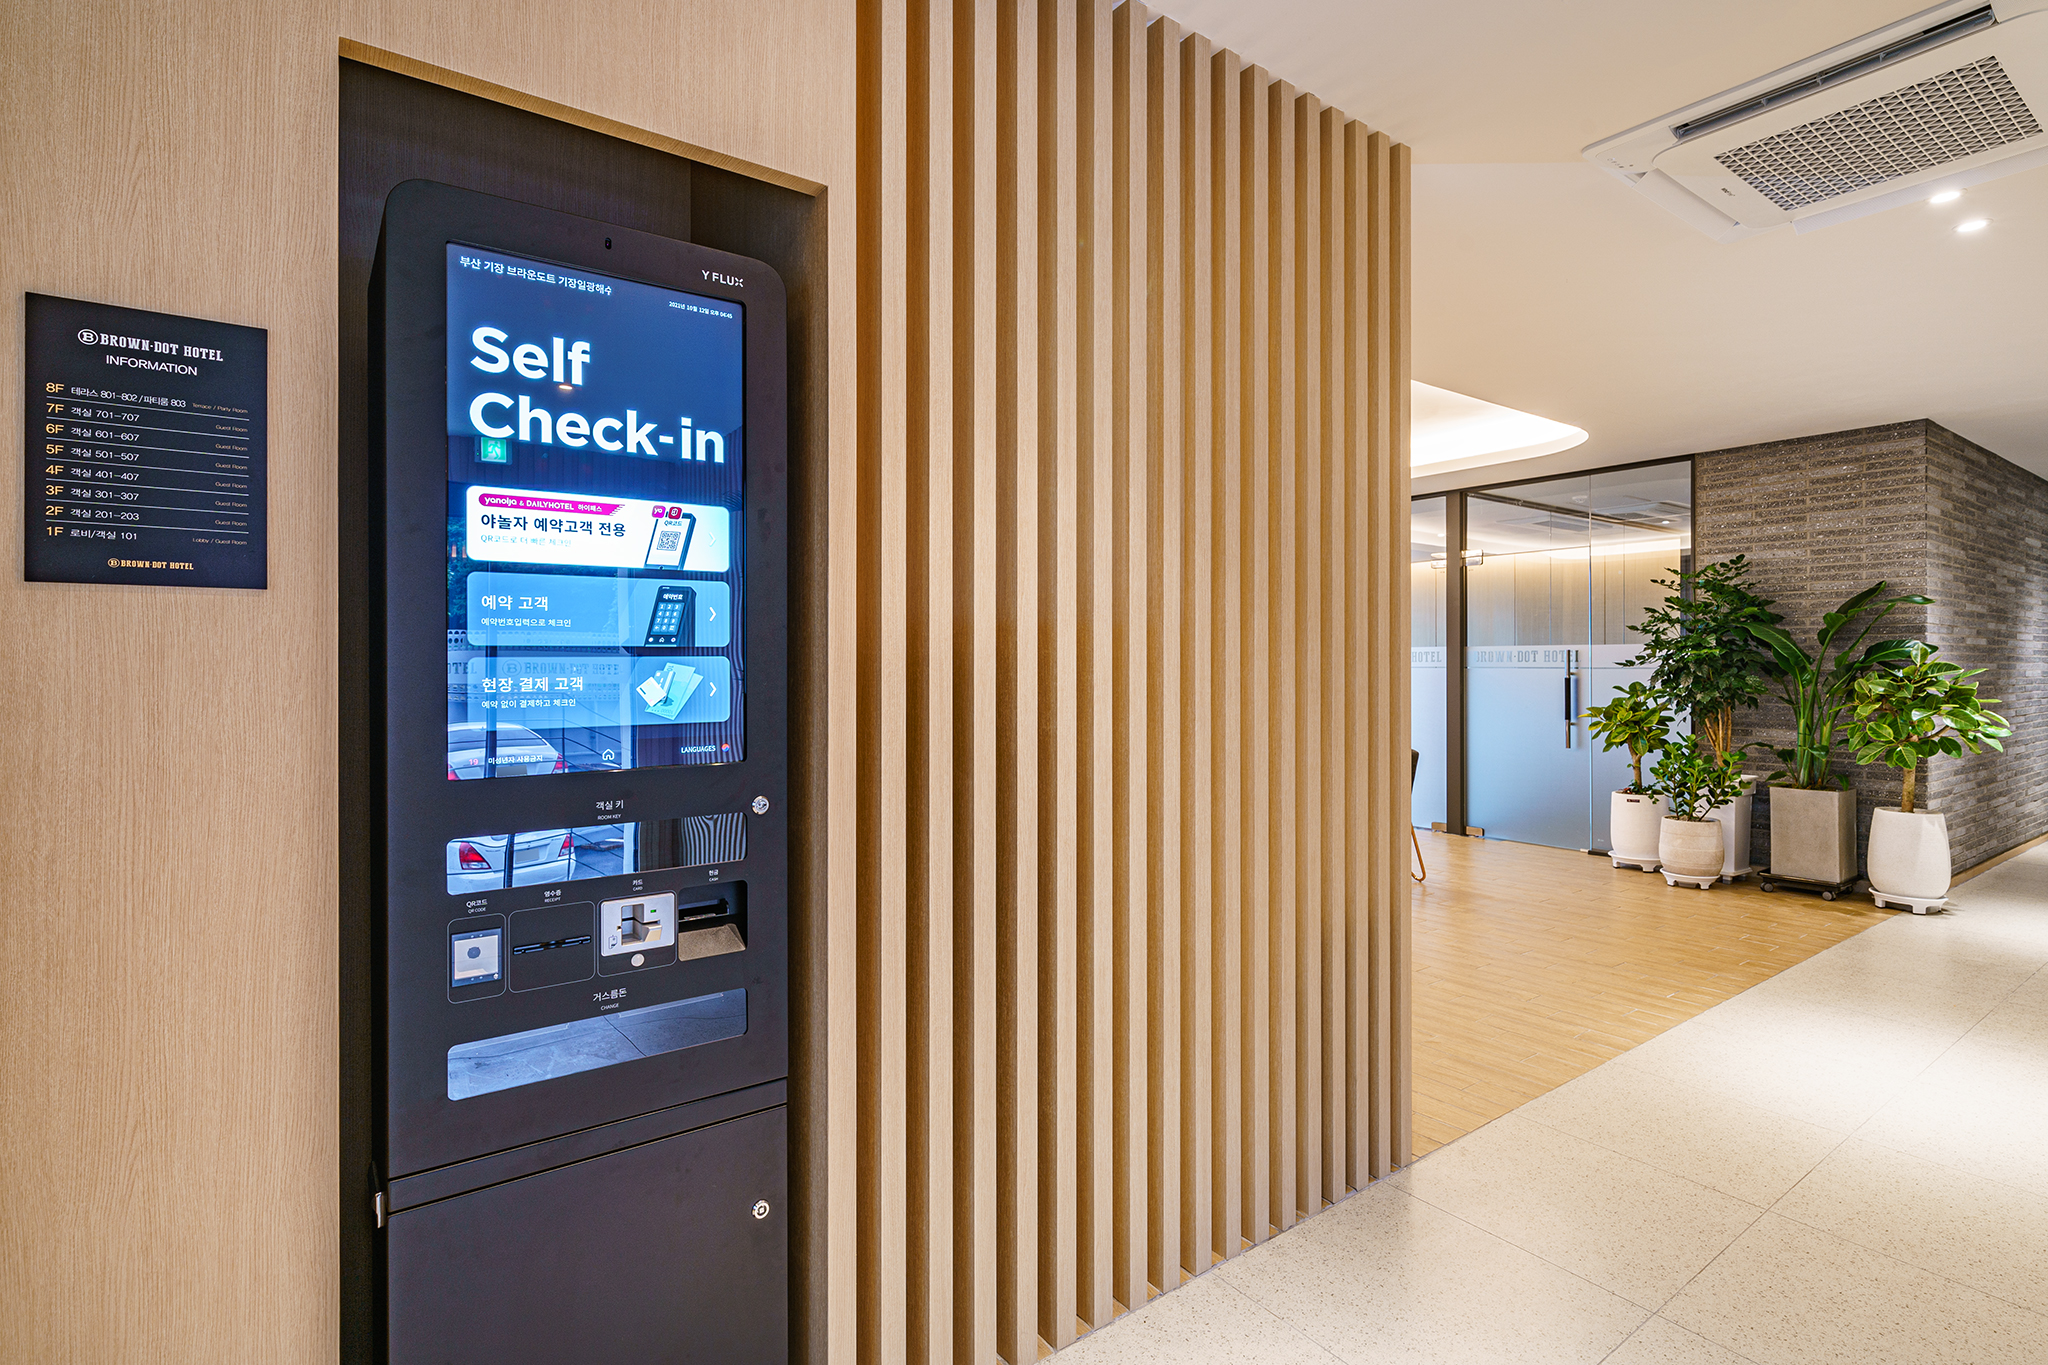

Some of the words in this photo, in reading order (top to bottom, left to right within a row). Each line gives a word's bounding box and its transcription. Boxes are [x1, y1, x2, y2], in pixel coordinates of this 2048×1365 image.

[459, 255, 481, 270] 부산
[483, 261, 505, 274] 기장
[506, 265, 556, 284] 브라운도트
[558, 276, 612, 296] 기장일광해수
[701, 269, 710, 280] Y
[712, 271, 744, 288] FLUX
[183, 345, 224, 362] HOTEL
[470, 326, 591, 386] Self
[106, 354, 198, 376] INFORMATION
[46, 382, 64, 393] 8F
[71, 386, 98, 398] 테라스
[170, 400, 186, 408] 803
[46, 403, 64, 414] 7F
[71, 407, 92, 417] 객실
[46, 423, 64, 434] 6F
[71, 427, 92, 438] 객실
[469, 392, 725, 463] Check-in
[45, 444, 64, 454] 5F
[70, 447, 92, 458] 객실
[45, 464, 64, 475] 4F
[70, 467, 92, 478] 객실
[45, 484, 64, 495] 3F
[70, 488, 92, 498] 객실
[484, 496, 518, 506] yanolja
[526, 500, 574, 510] DAILYHOTEL
[45, 505, 64, 516] 2F
[70, 508, 92, 518] 객실
[46, 526, 64, 536] 1F
[121, 532, 137, 540] 101
[481, 514, 528, 531] 야놀자
[533, 517, 593, 535] 예약고객
[598, 522, 626, 538] 전용
[169, 562, 194, 570] HOTEL
[481, 594, 513, 611] 예약
[518, 596, 549, 612] 고객
[481, 617, 546, 627] 예약번호입력으로
[547, 619, 572, 628] 체크인
[1411, 651, 1442, 663] HOTEL
[481, 678, 513, 693] 현장
[519, 677, 549, 692] 결제
[554, 676, 583, 691] 고객
[481, 700, 498, 709] 예약
[501, 699, 517, 708] 없이
[519, 699, 551, 708] 결제하고
[553, 698, 576, 707] 체크인
[681, 745, 716, 753] LANGUAGES
[468, 758, 479, 766] 19
[488, 757, 515, 765] 미성년자
[516, 755, 543, 763] 사용금지
[595, 800, 613, 811] 객실
[615, 799, 624, 809] 키
[466, 899, 488, 908] QR코드
[593, 988, 627, 1002] 거스름돈
[600, 1003, 619, 1011] CHANGE
